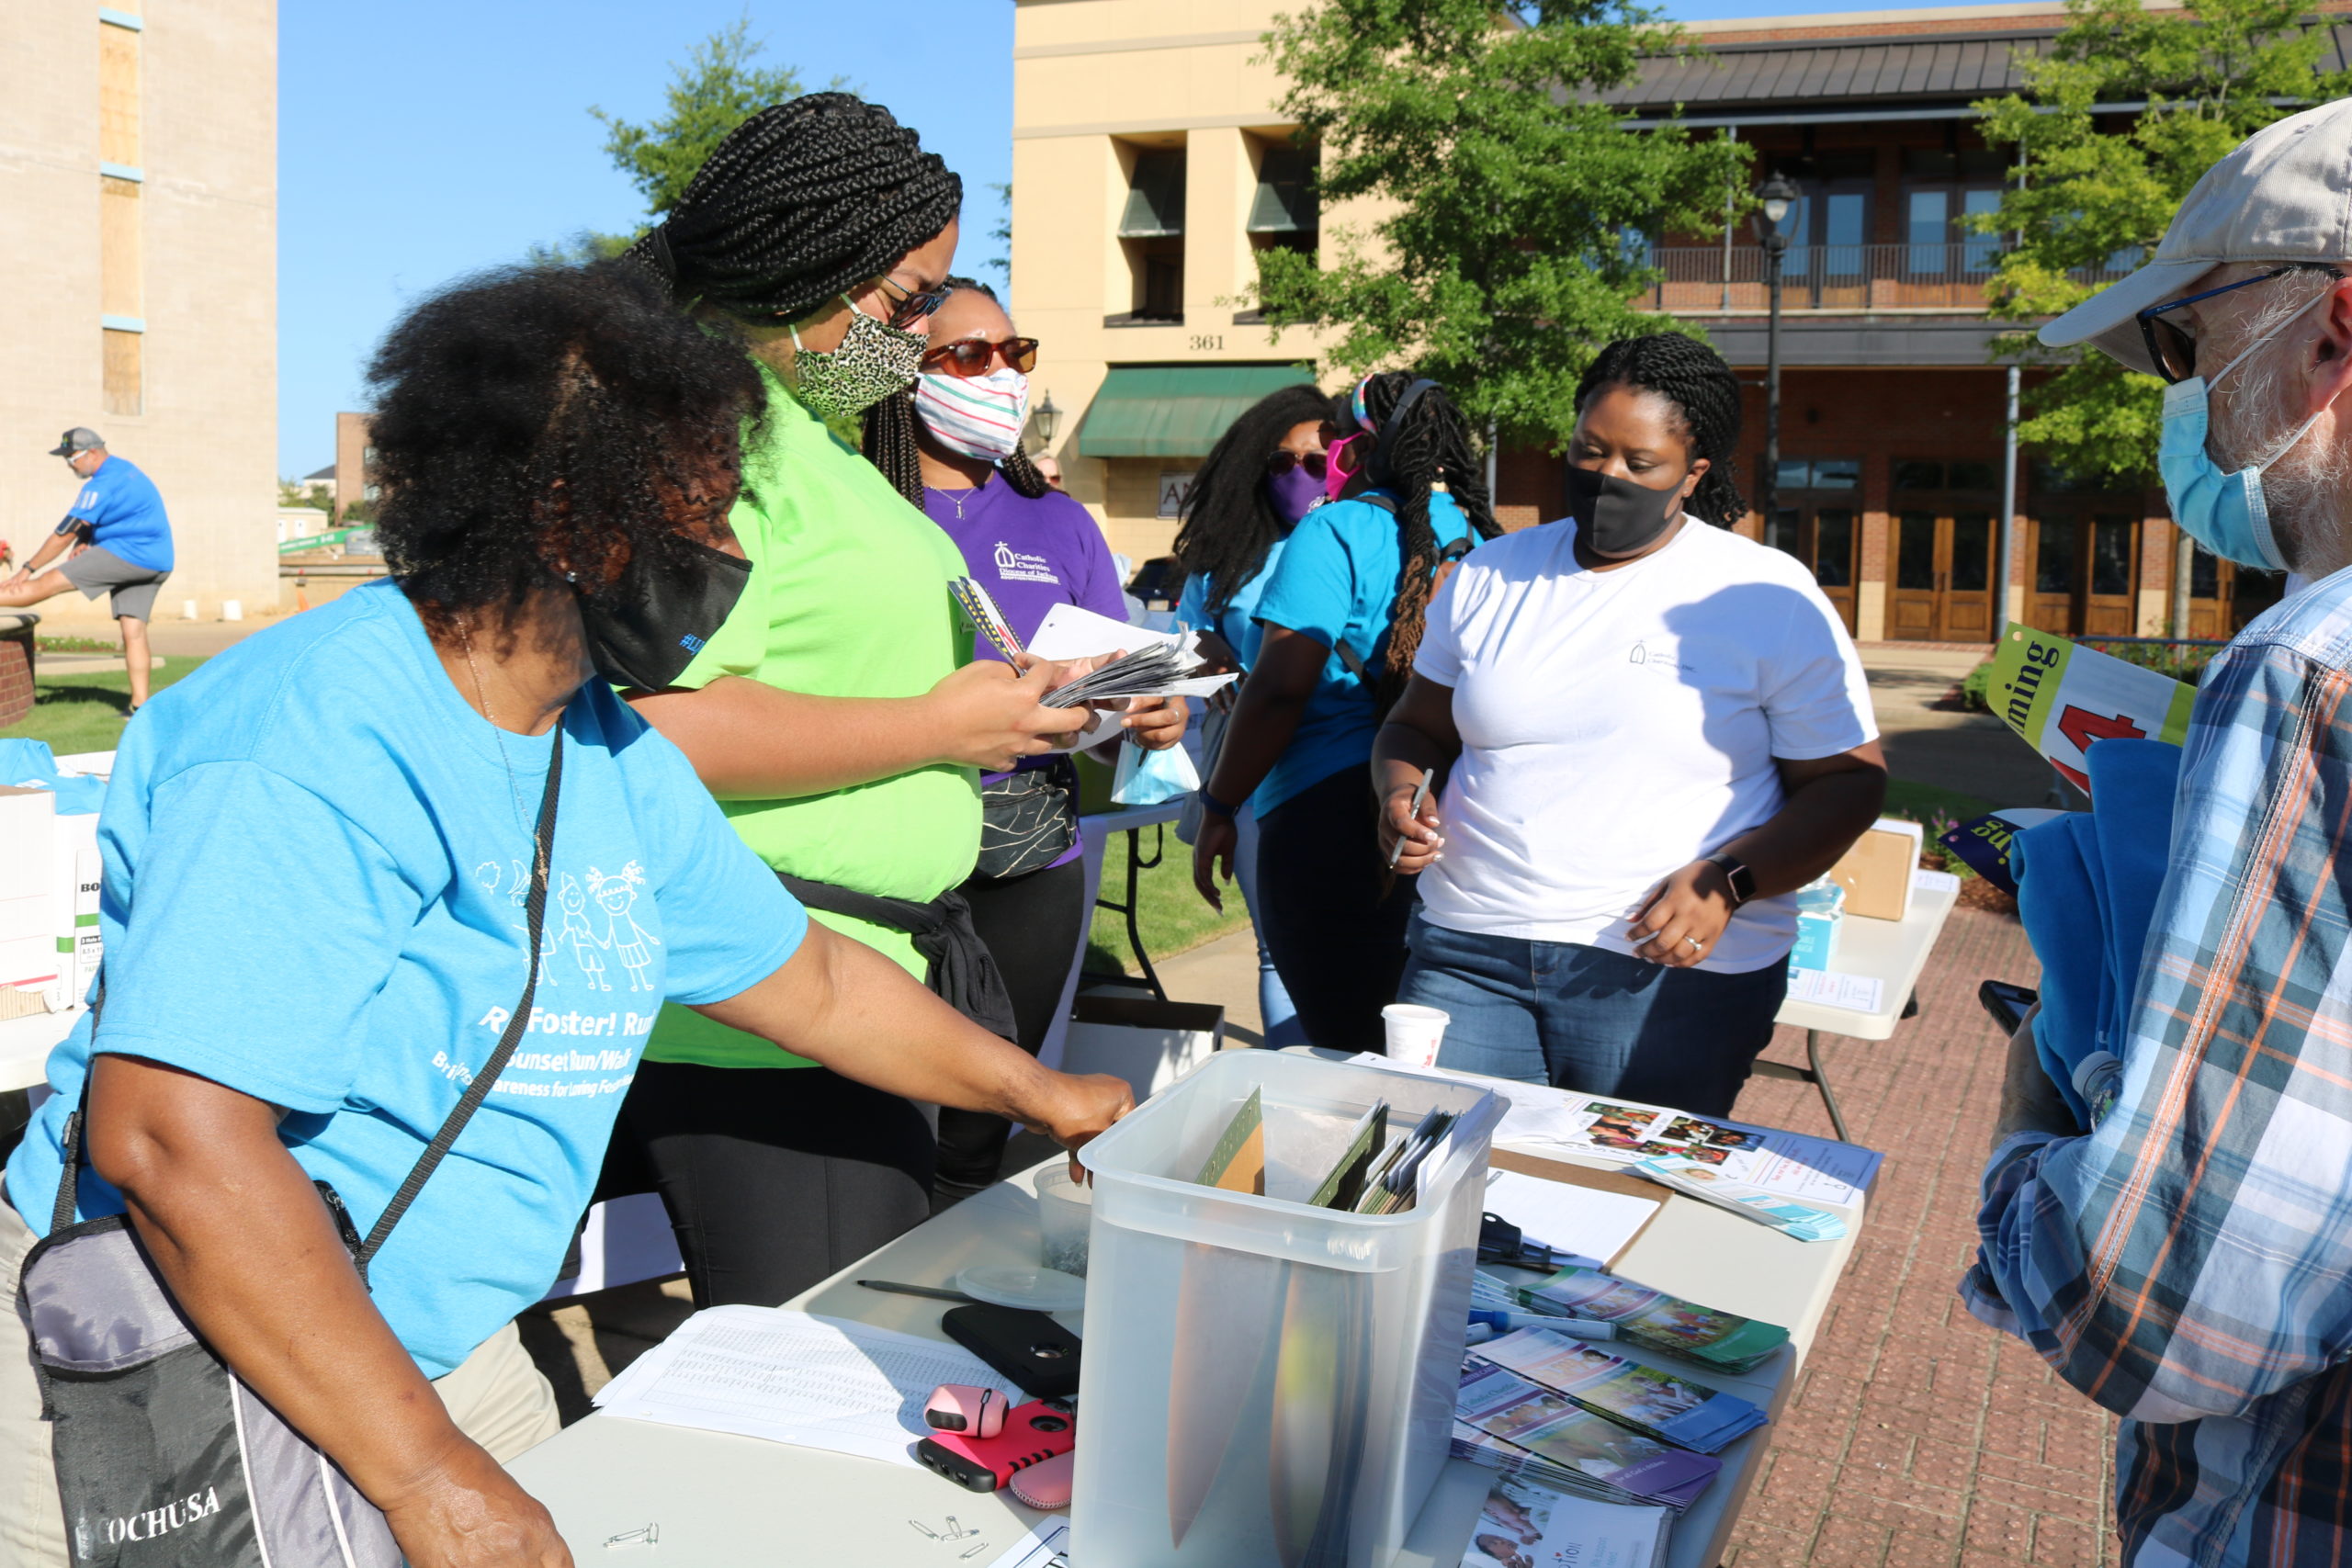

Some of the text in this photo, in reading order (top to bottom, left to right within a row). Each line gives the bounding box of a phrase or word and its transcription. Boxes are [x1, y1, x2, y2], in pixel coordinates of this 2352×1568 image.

[1190, 333, 1225, 351] 361
[1014, 553, 1046, 563] Catholic
[1016, 561, 1051, 572] Charities
[526, 1007, 616, 1037] Foster!
